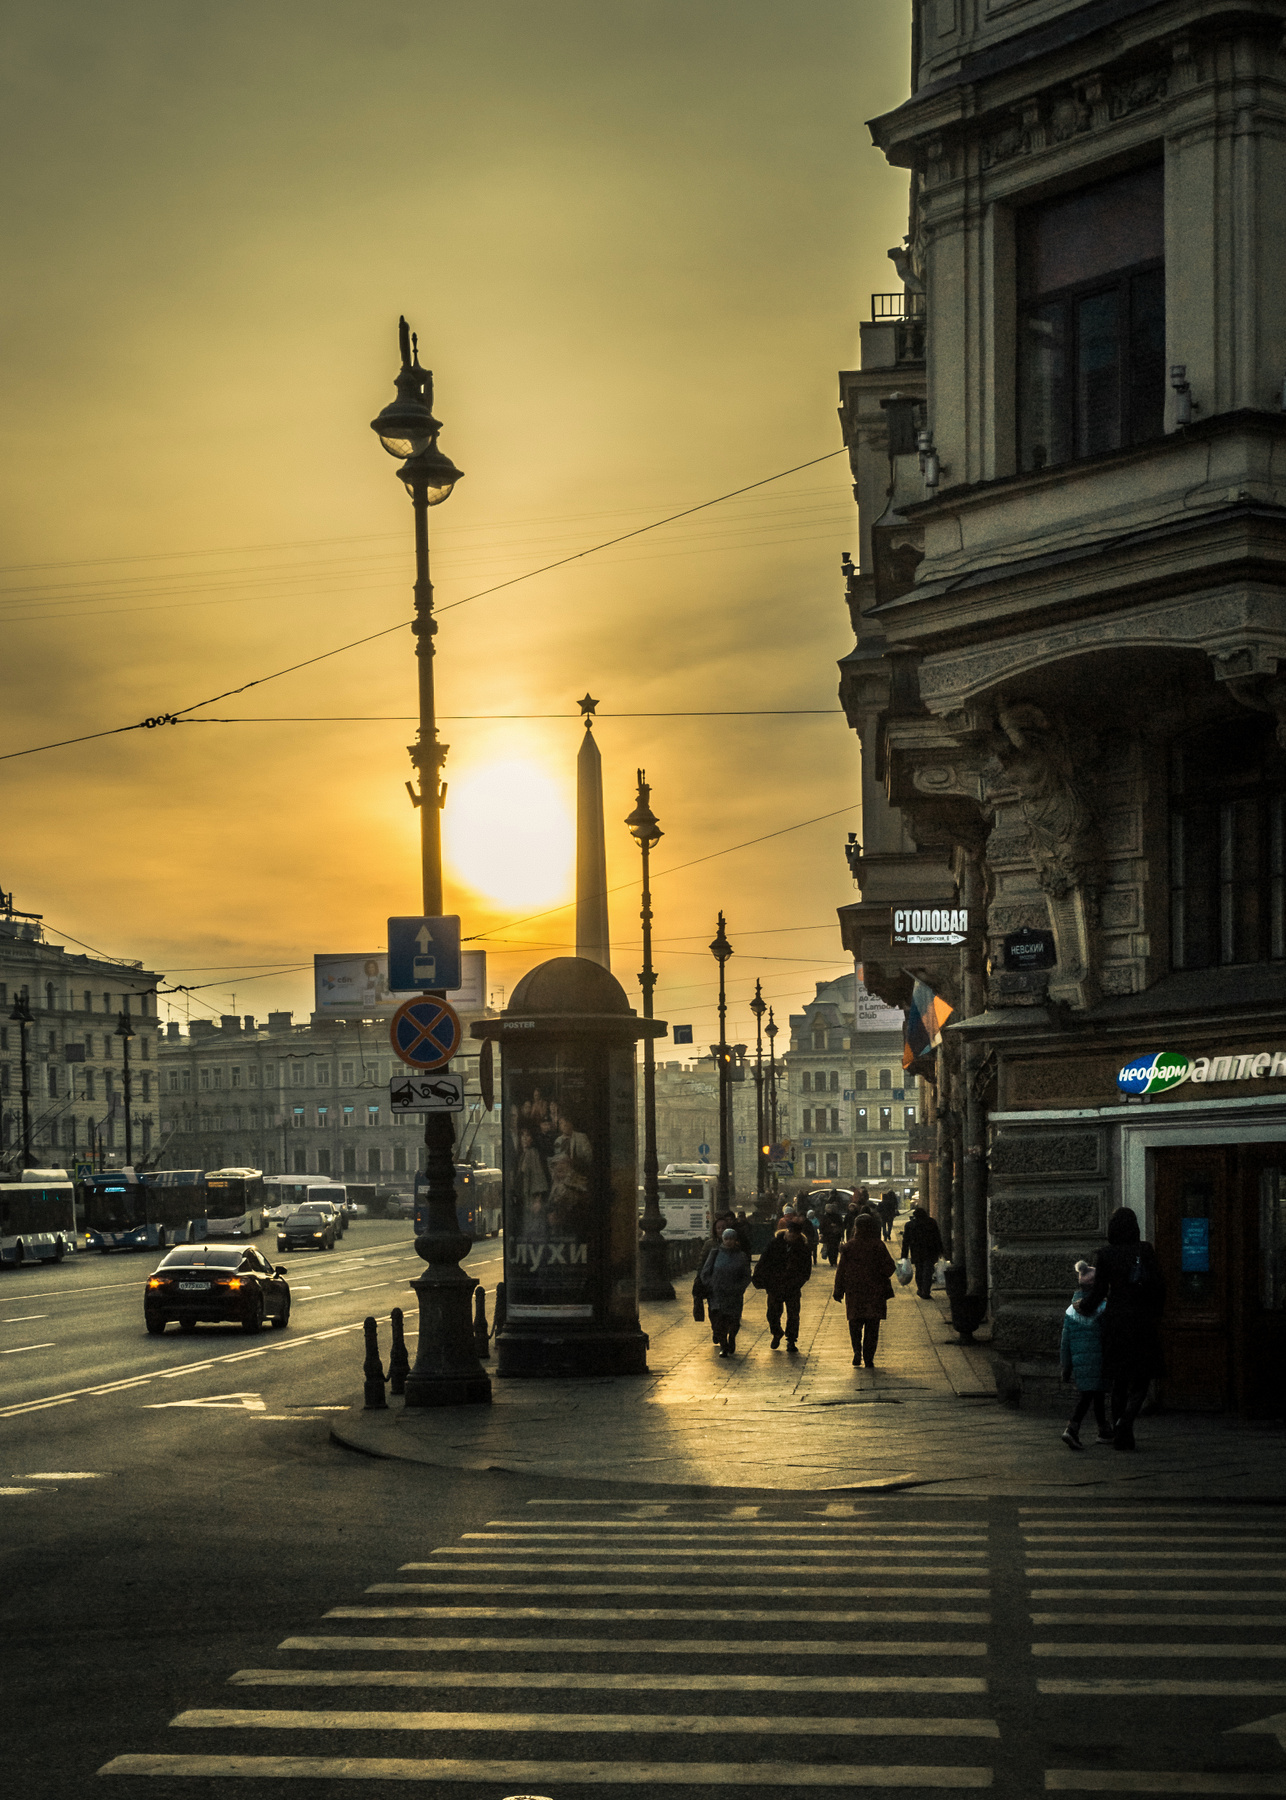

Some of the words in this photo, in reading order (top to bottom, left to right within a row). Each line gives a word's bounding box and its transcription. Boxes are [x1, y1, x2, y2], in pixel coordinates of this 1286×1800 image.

[894, 909, 968, 933] СТОЛОВАЯ
[1010, 941, 1044, 955] НЕВСКИЙ
[337, 976, 352, 984] сбп
[503, 1021, 535, 1029] POSTER
[1118, 1064, 1187, 1083] неофарм
